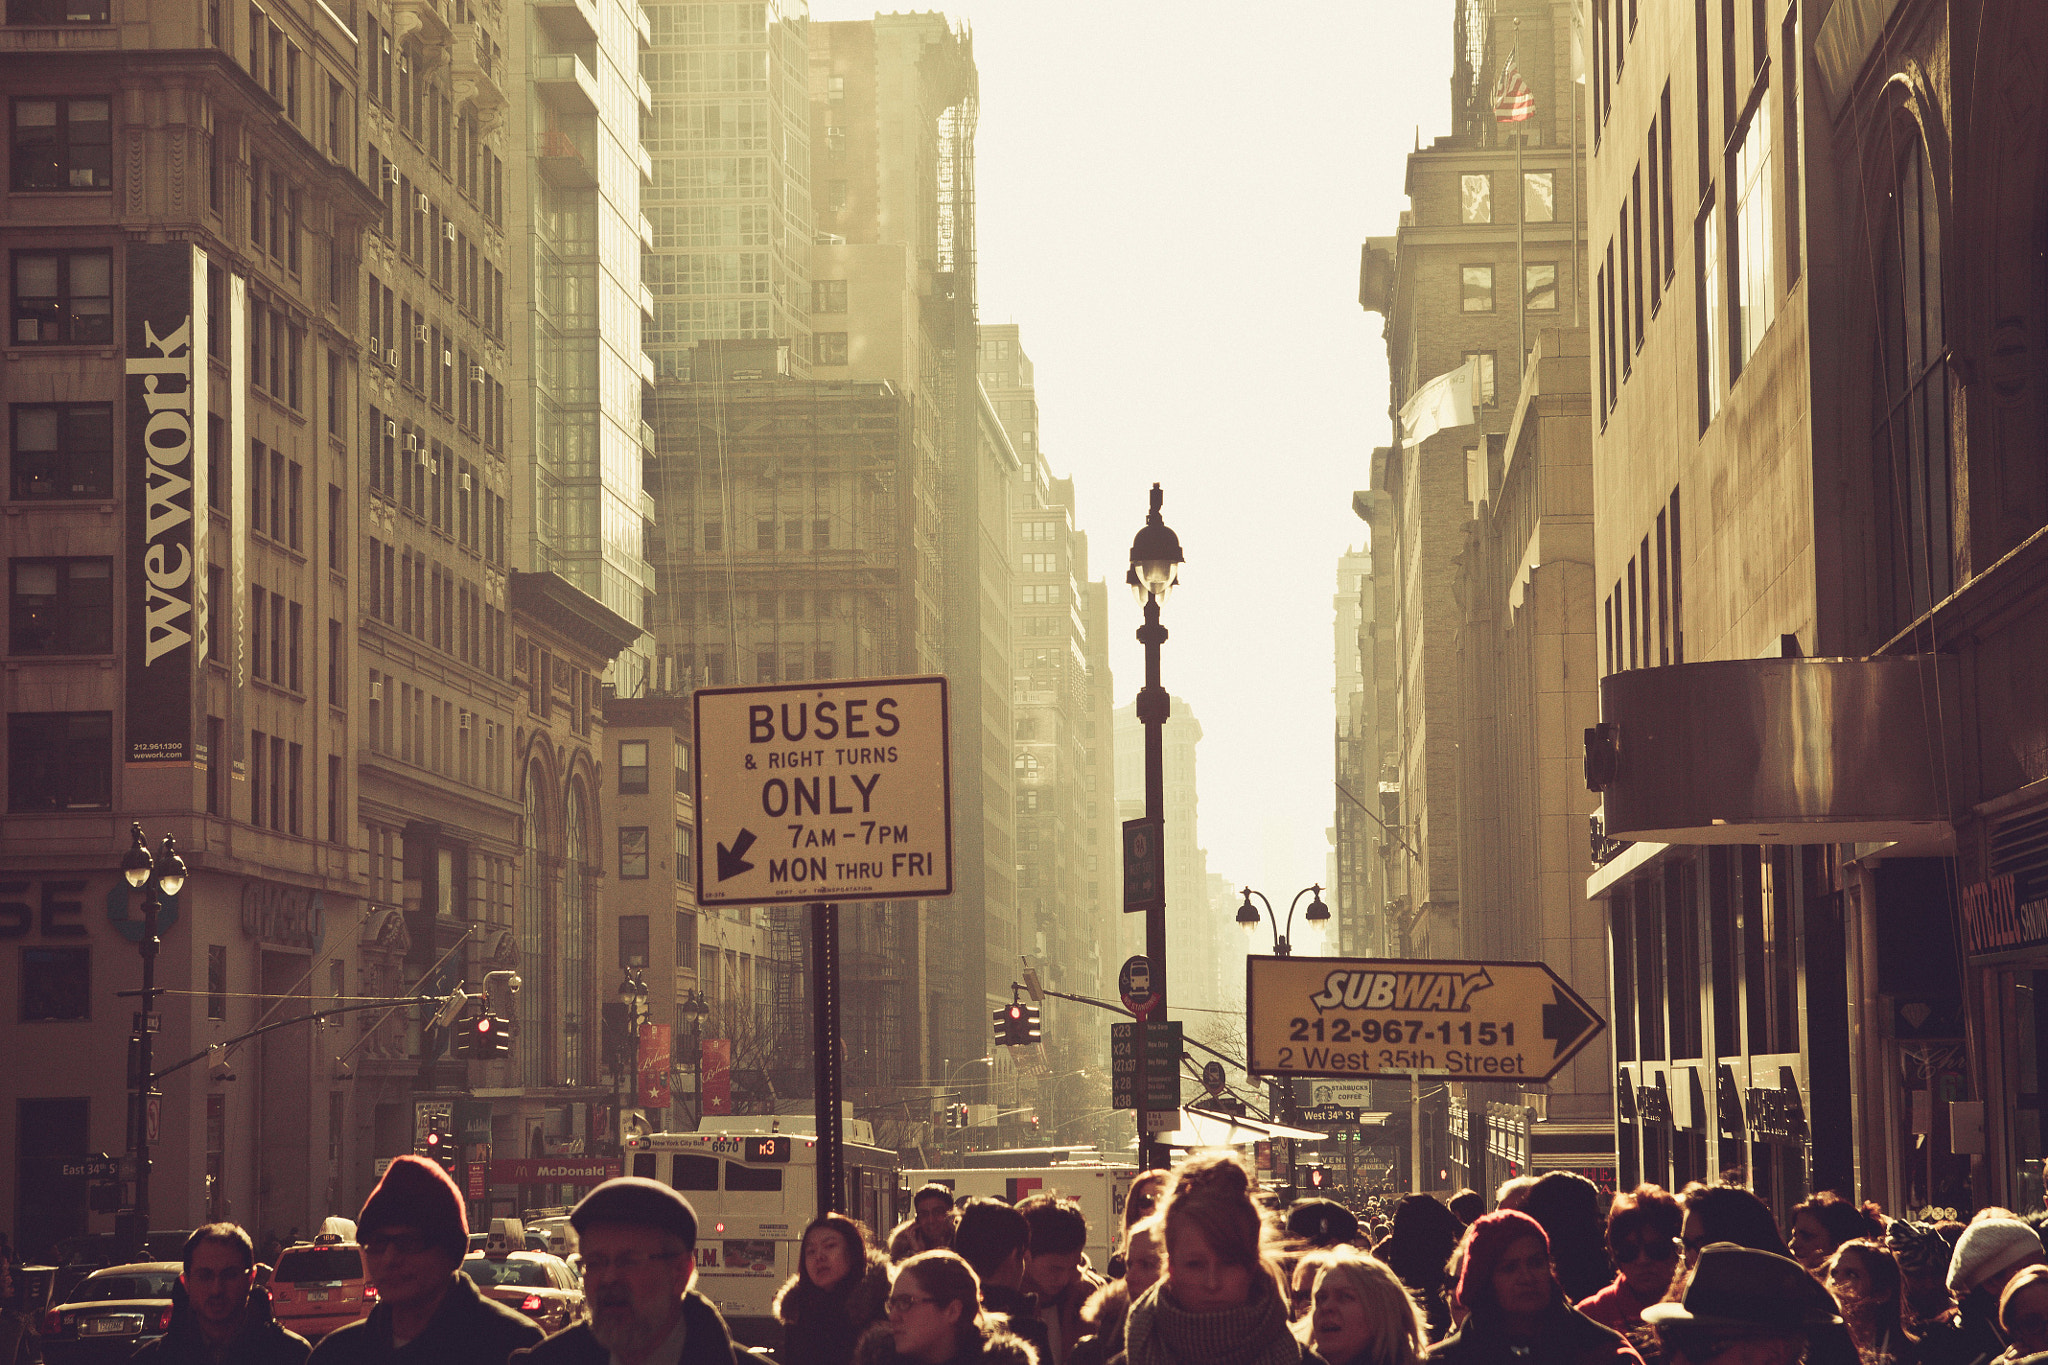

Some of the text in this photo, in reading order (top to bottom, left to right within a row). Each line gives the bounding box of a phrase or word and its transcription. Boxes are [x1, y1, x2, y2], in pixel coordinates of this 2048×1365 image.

[125, 315, 192, 668] wework
[749, 698, 901, 744] BUSES
[133, 742, 183, 751] 212.961.1300
[133, 751, 183, 759] wework.com
[744, 746, 899, 771] & RIGHT TURNS
[762, 773, 882, 819] ONLY
[769, 851, 933, 883] MON THRU FRI
[242, 881, 311, 949] CHASE
[1961, 872, 2022, 951] POTBELLY
[1313, 967, 1490, 1013] SUBWAY
[1289, 1017, 1515, 1047] 212-967-1151
[1277, 1047, 1525, 1074] 2 West 35th Street
[1304, 1110, 1355, 1120] West 34th St
[680, 1140, 692, 1148] City
[711, 1141, 739, 1153] 6670
[63, 1164, 85, 1175] East
